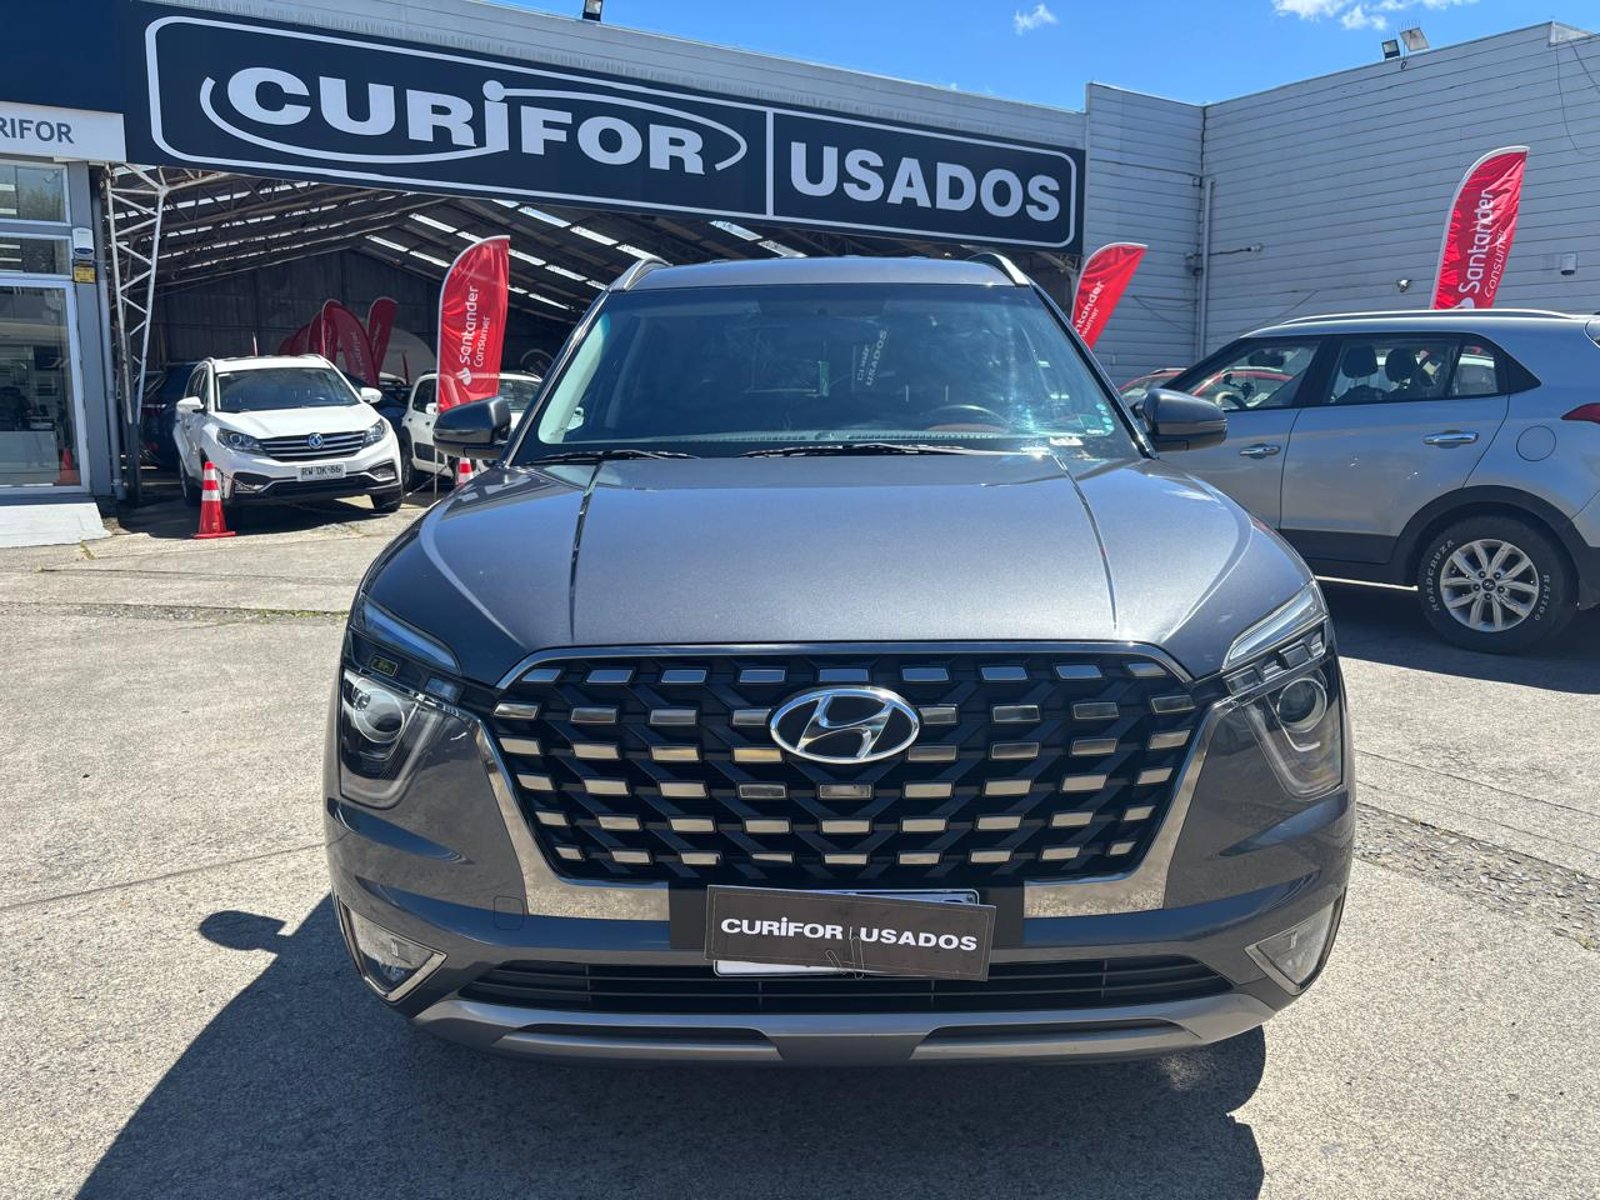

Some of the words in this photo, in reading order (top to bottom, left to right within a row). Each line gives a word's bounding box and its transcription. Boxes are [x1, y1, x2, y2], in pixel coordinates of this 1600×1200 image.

[790, 141, 1061, 222] USADOS
[1458, 190, 1494, 294] Santander
[1484, 227, 1508, 298] Consumer
[460, 285, 479, 366] Santander
[1076, 281, 1105, 333] ntander
[1081, 307, 1099, 337] sumer
[473, 316, 491, 368] Consumer
[859, 927, 978, 951] USADOS
